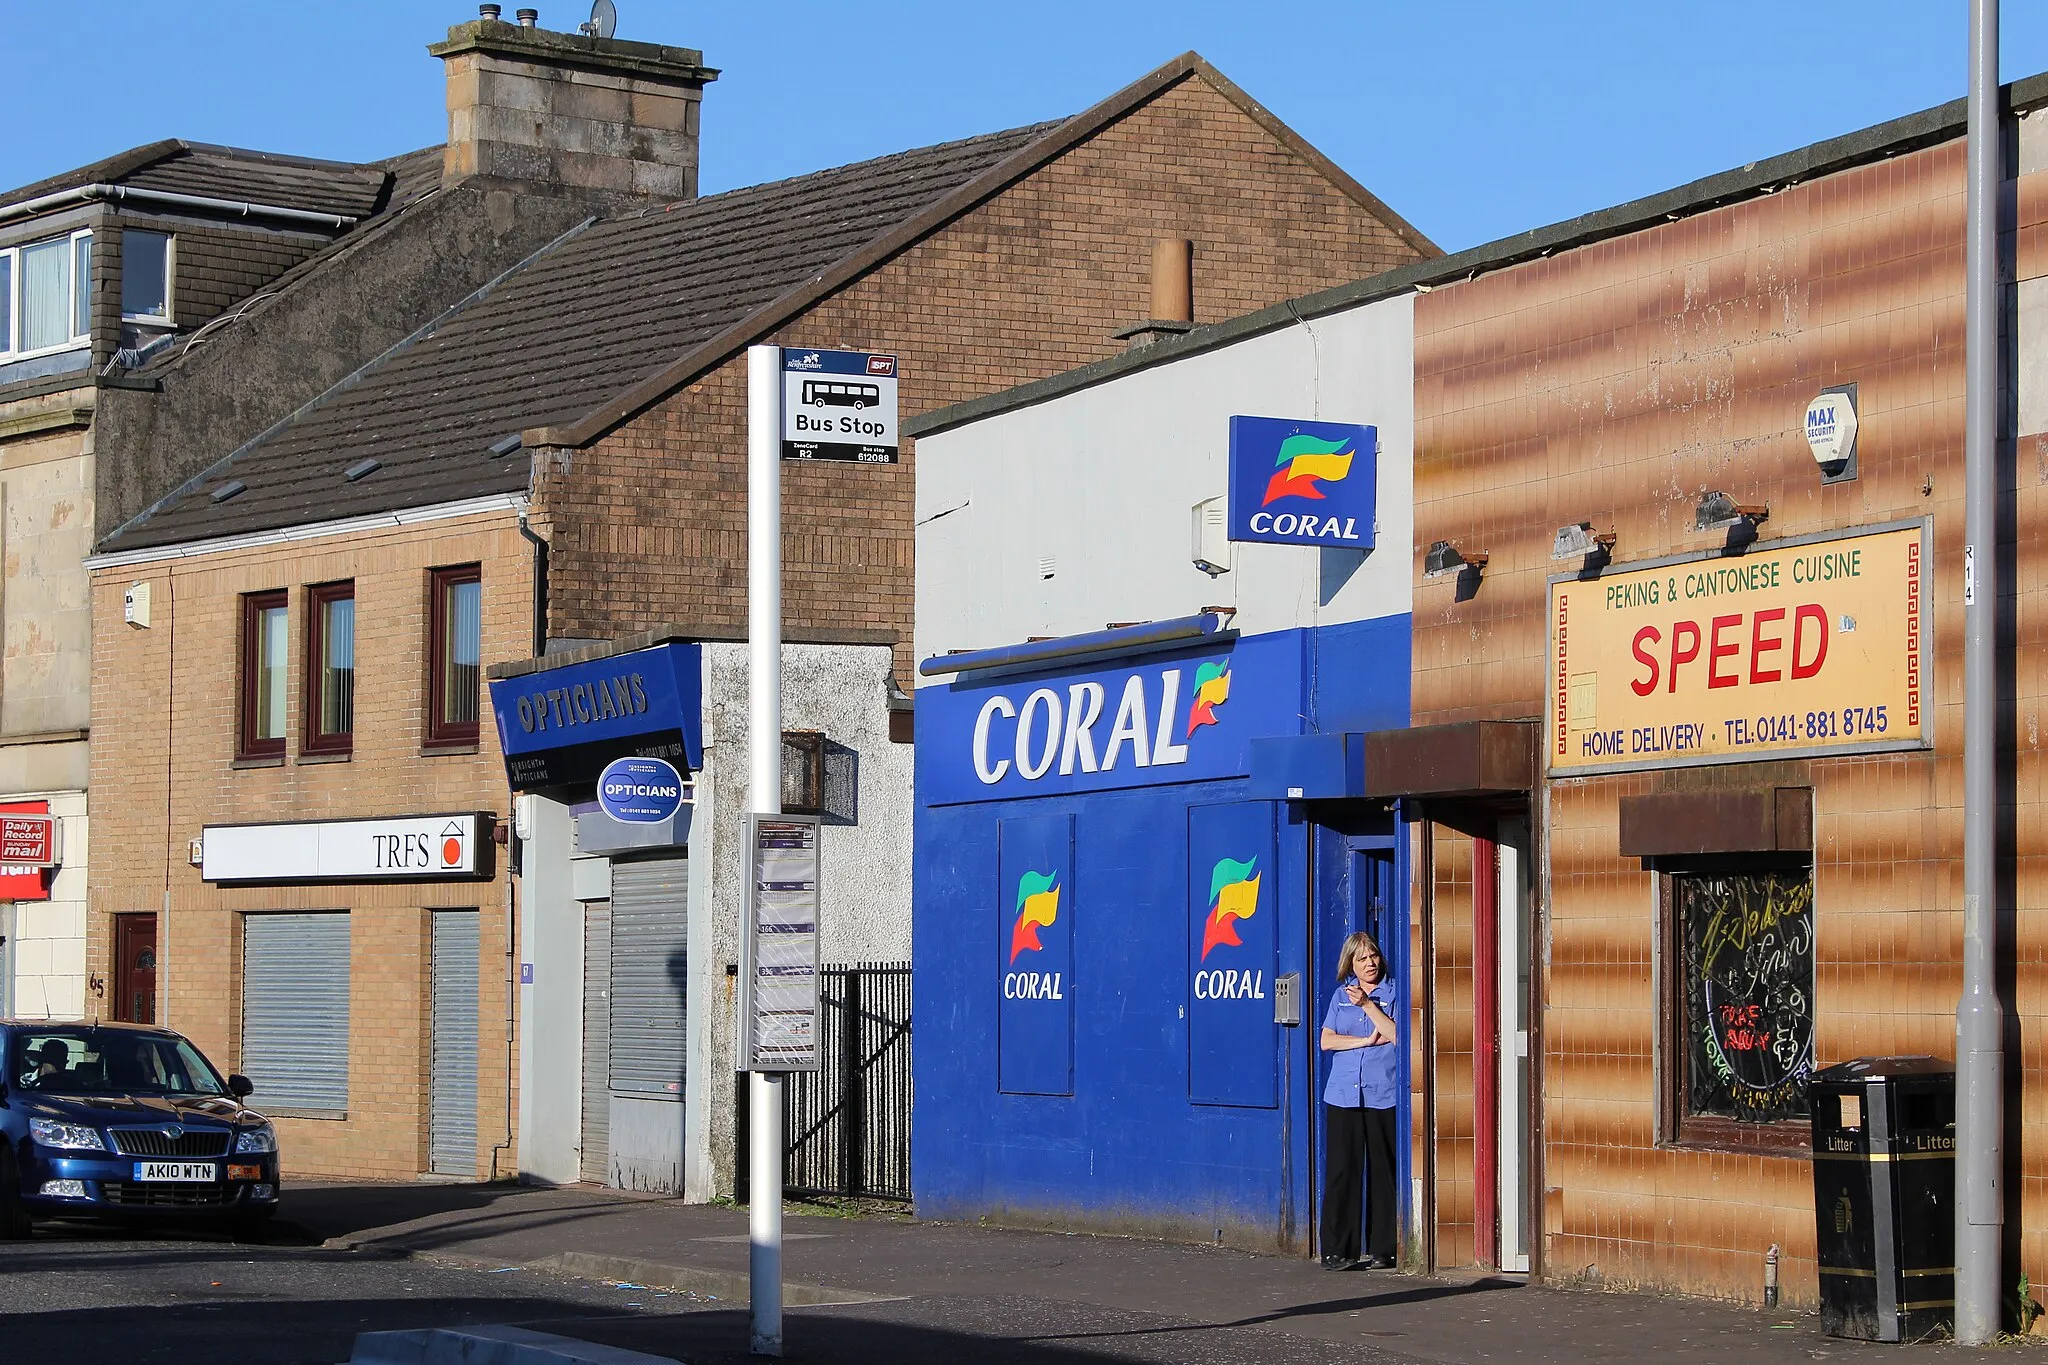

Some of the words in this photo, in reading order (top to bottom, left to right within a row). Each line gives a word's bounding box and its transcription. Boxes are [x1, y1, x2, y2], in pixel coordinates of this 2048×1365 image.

[796, 414, 833, 432] Bus
[839, 416, 885, 438] Stop
[1807, 406, 1836, 428] MAX
[1807, 425, 1837, 438] SECURITY
[799, 449, 812, 458] R2
[858, 453, 889, 462] 612088
[1249, 511, 1360, 540] CORAL
[1606, 580, 1660, 610] PEKING
[1667, 577, 1678, 602] &
[1685, 561, 1780, 599] CANTONESE
[1793, 550, 1861, 583] CUISINE
[1630, 603, 1829, 697] SPEED
[517, 673, 647, 733] OPTICIANS
[972, 669, 1189, 784] CORAL
[1582, 730, 1624, 757] HOME
[1632, 723, 1705, 754] DELIVERY
[1843, 705, 1888, 735] 8745
[604, 784, 678, 798] OPTICIANS
[4, 830, 43, 840] Record
[5, 821, 33, 832] Daily
[3, 843, 42, 857] mail
[372, 833, 429, 868] TRFS
[90, 970, 104, 999] 65
[1004, 972, 1063, 1000] CORAL
[1194, 969, 1265, 1000] CORAL
[1828, 1136, 1854, 1152] Litter
[147, 1164, 180, 1178] AK10
[183, 1164, 212, 1179] WTN
